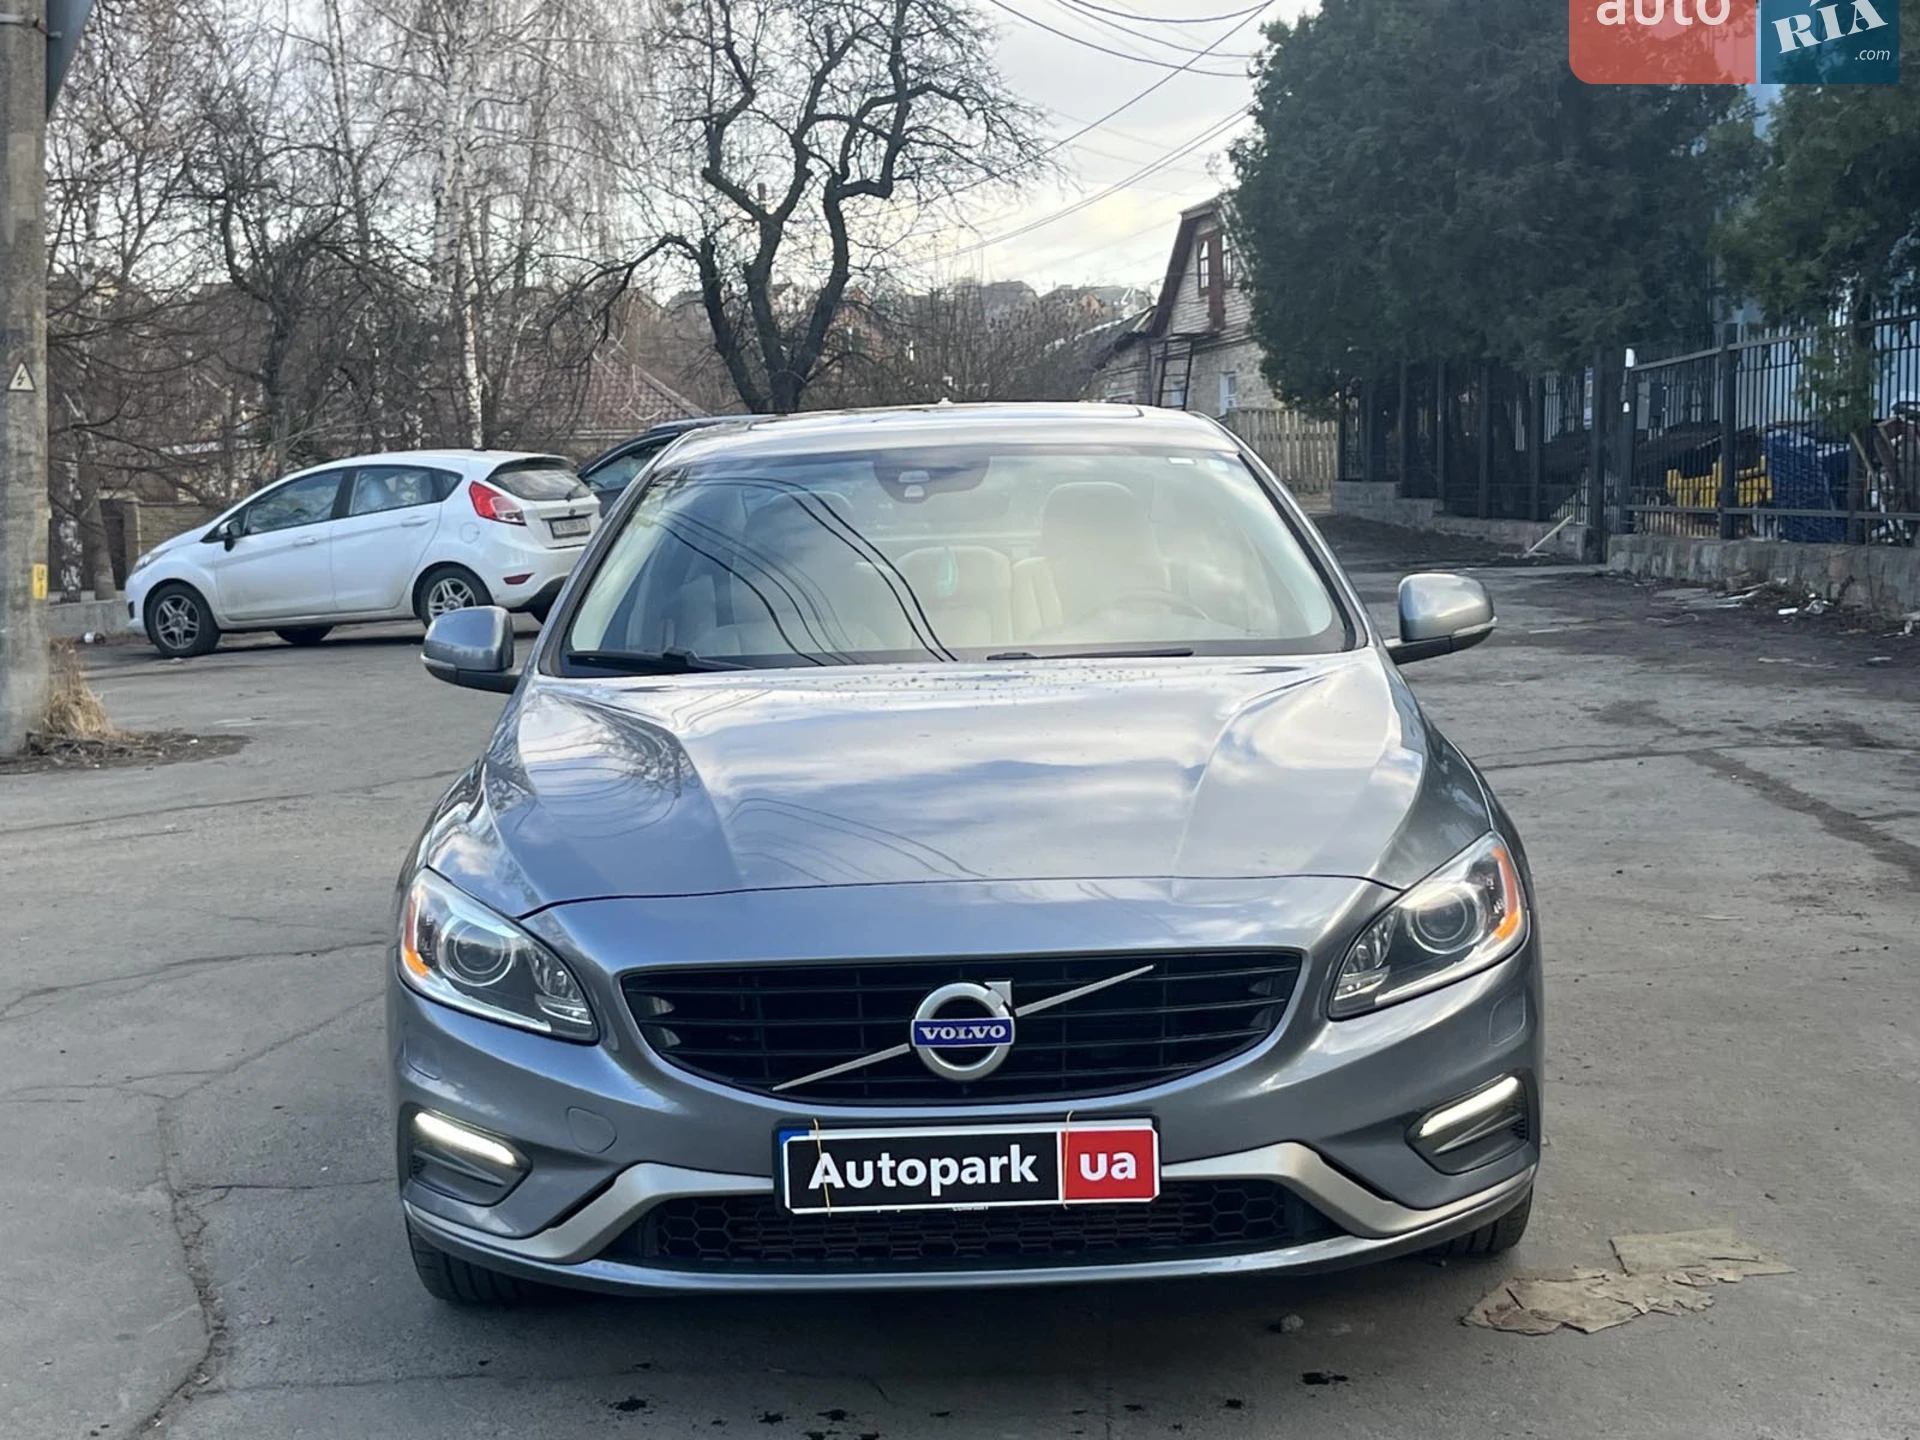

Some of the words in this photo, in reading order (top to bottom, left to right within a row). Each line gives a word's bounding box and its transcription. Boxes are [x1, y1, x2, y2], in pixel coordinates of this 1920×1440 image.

[919, 1025, 1006, 1040] VOLVO
[808, 1144, 1039, 1196] Autopark
[1080, 1151, 1136, 1181] ua
